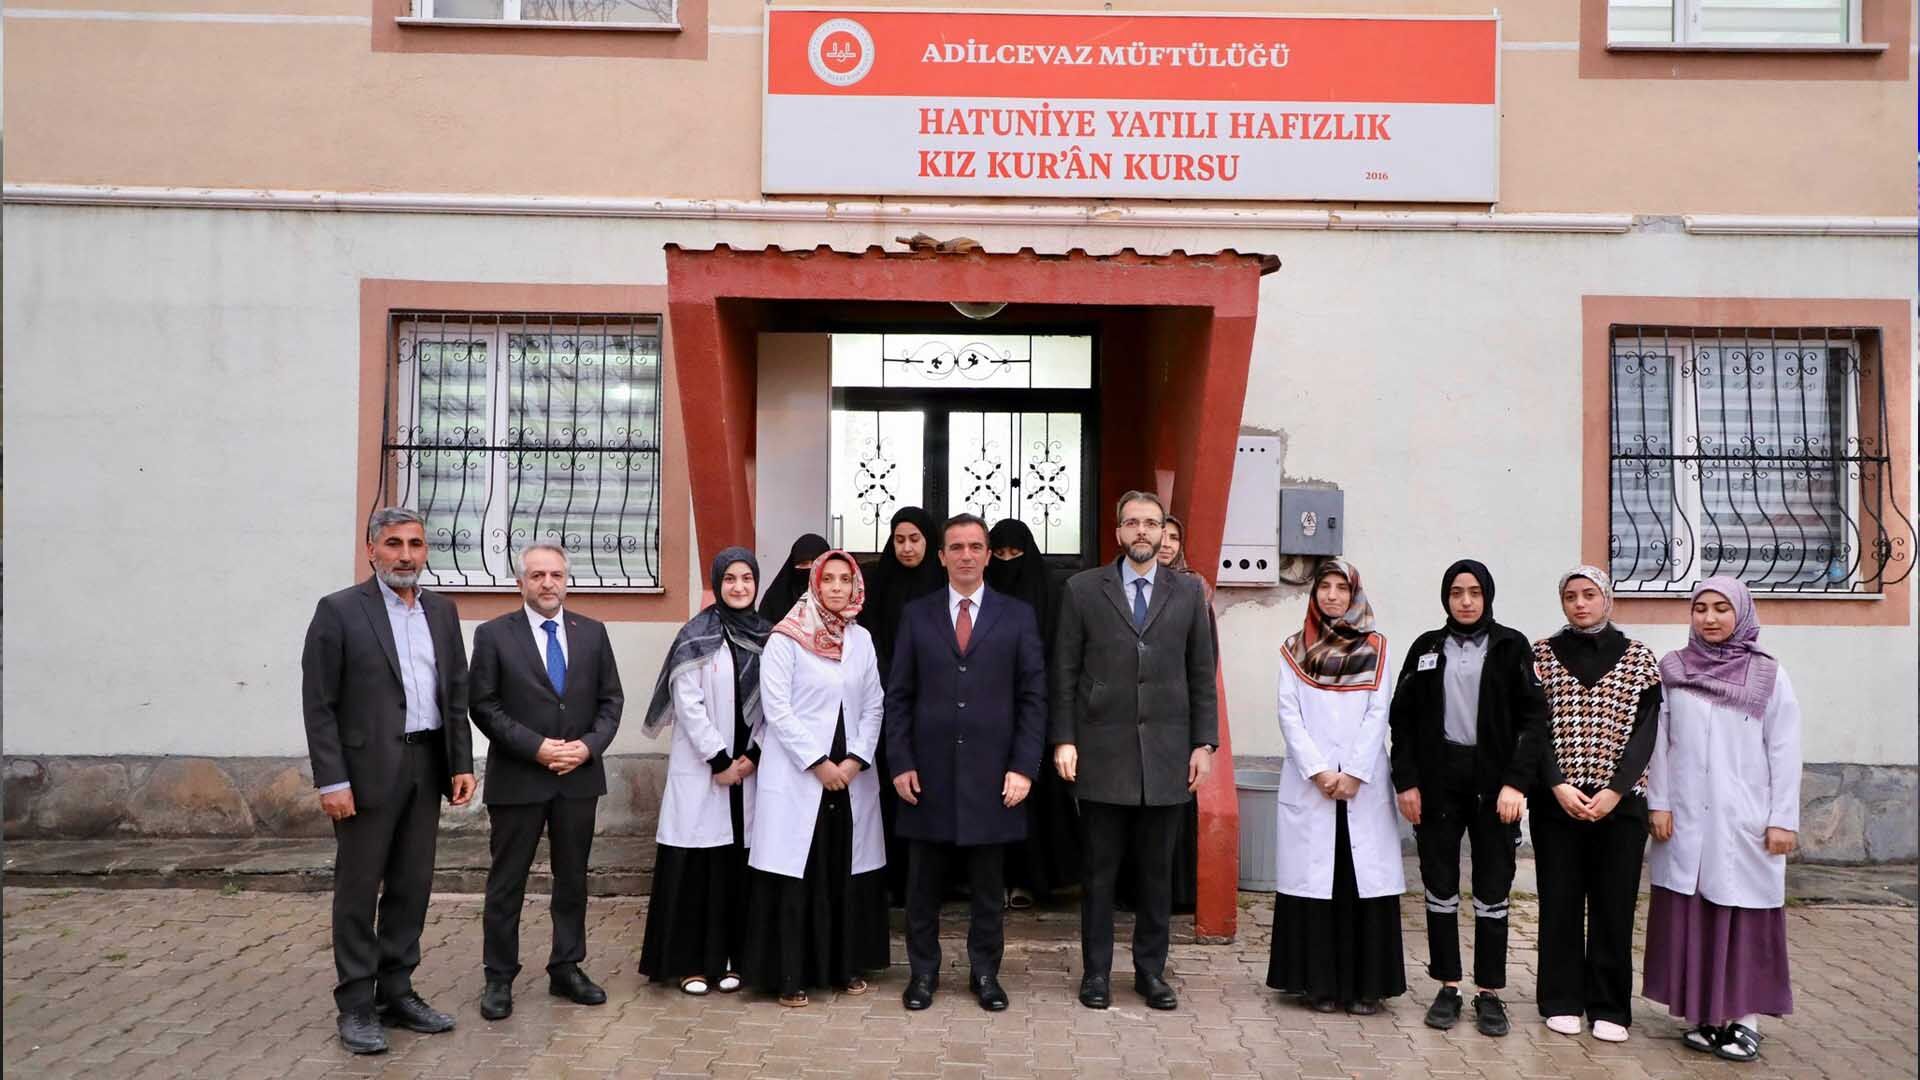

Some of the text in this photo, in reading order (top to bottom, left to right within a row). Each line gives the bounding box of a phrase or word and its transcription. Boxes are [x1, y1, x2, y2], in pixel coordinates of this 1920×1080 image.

[921, 38, 1290, 68] ADİLCEVAZ MÜFTÜLÜĞÜ
[918, 101, 1392, 141] HATUNİYE YATILI HAFIZLIK
[917, 150, 976, 178] KIZ
[1123, 153, 1241, 182] KURSU
[1365, 172, 1389, 181] 2016
